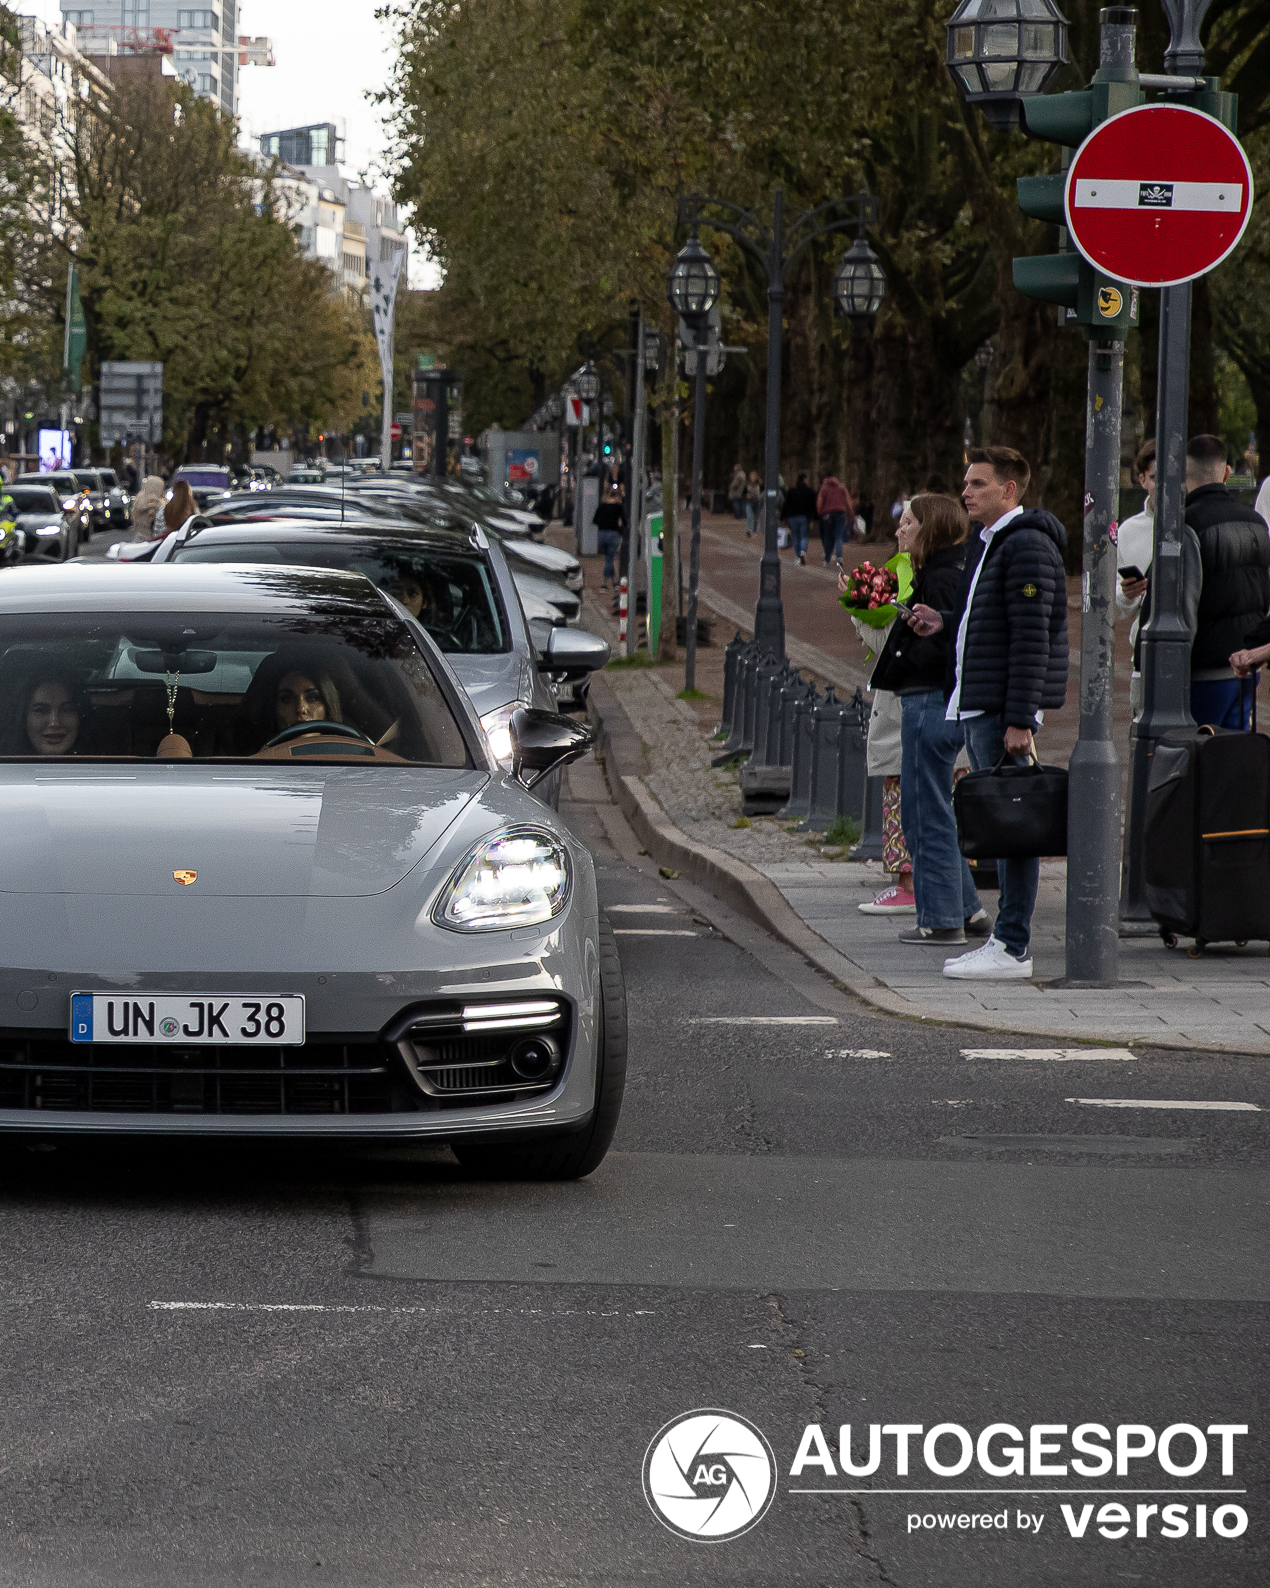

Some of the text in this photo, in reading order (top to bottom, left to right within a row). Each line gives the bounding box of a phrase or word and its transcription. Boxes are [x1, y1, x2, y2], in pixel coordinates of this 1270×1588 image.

[78, 1023, 88, 1034] D
[107, 1001, 286, 1039] UN JK 38
